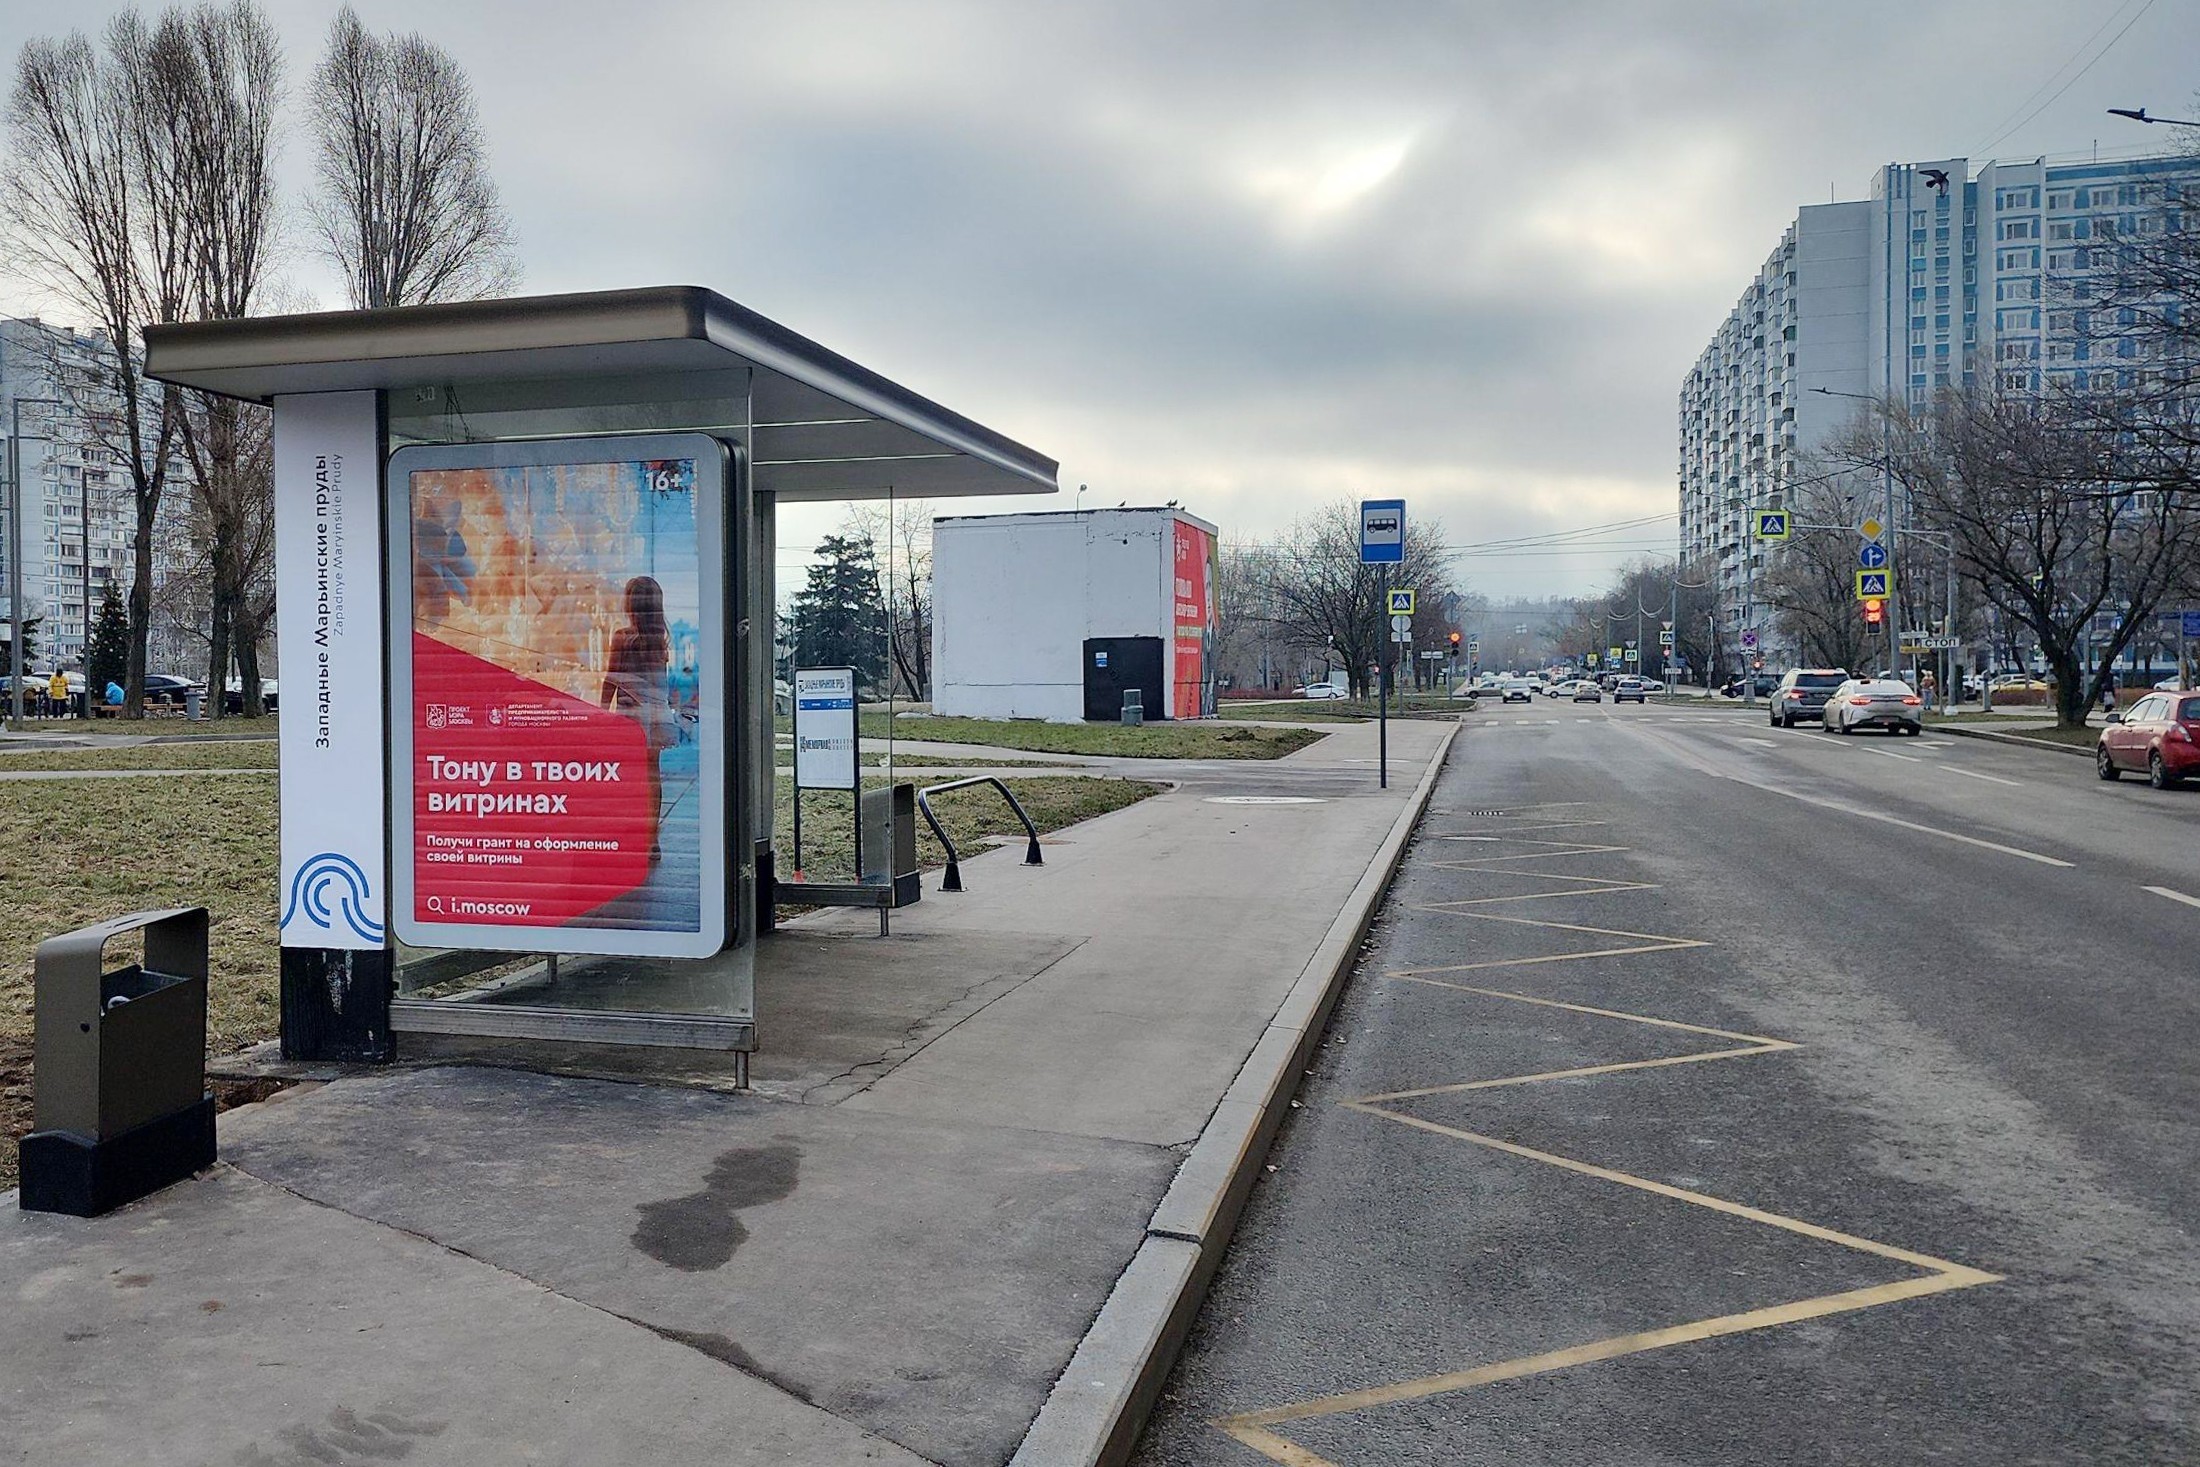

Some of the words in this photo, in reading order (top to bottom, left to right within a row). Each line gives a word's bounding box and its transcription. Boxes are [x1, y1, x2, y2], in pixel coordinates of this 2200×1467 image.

[315, 455, 330, 517] пруды
[330, 454, 343, 492] Prudy
[645, 470, 682, 491] 16+
[331, 496, 344, 569] Maryinskie
[314, 523, 330, 647] Марьинские
[332, 572, 345, 636] Zapadnye
[1925, 639, 1956, 647] СТОП
[315, 652, 330, 748] Западные
[426, 755, 497, 787] Тону
[506, 762, 523, 781] в
[531, 761, 621, 782] твоих
[428, 792, 568, 819] витринах
[426, 834, 473, 849] Получи
[476, 837, 512, 850] грант
[515, 838, 531, 849] на
[534, 837, 619, 851] оформление
[426, 850, 464, 863] своей
[467, 853, 523, 865] витрины
[450, 897, 531, 916] i.moscow
